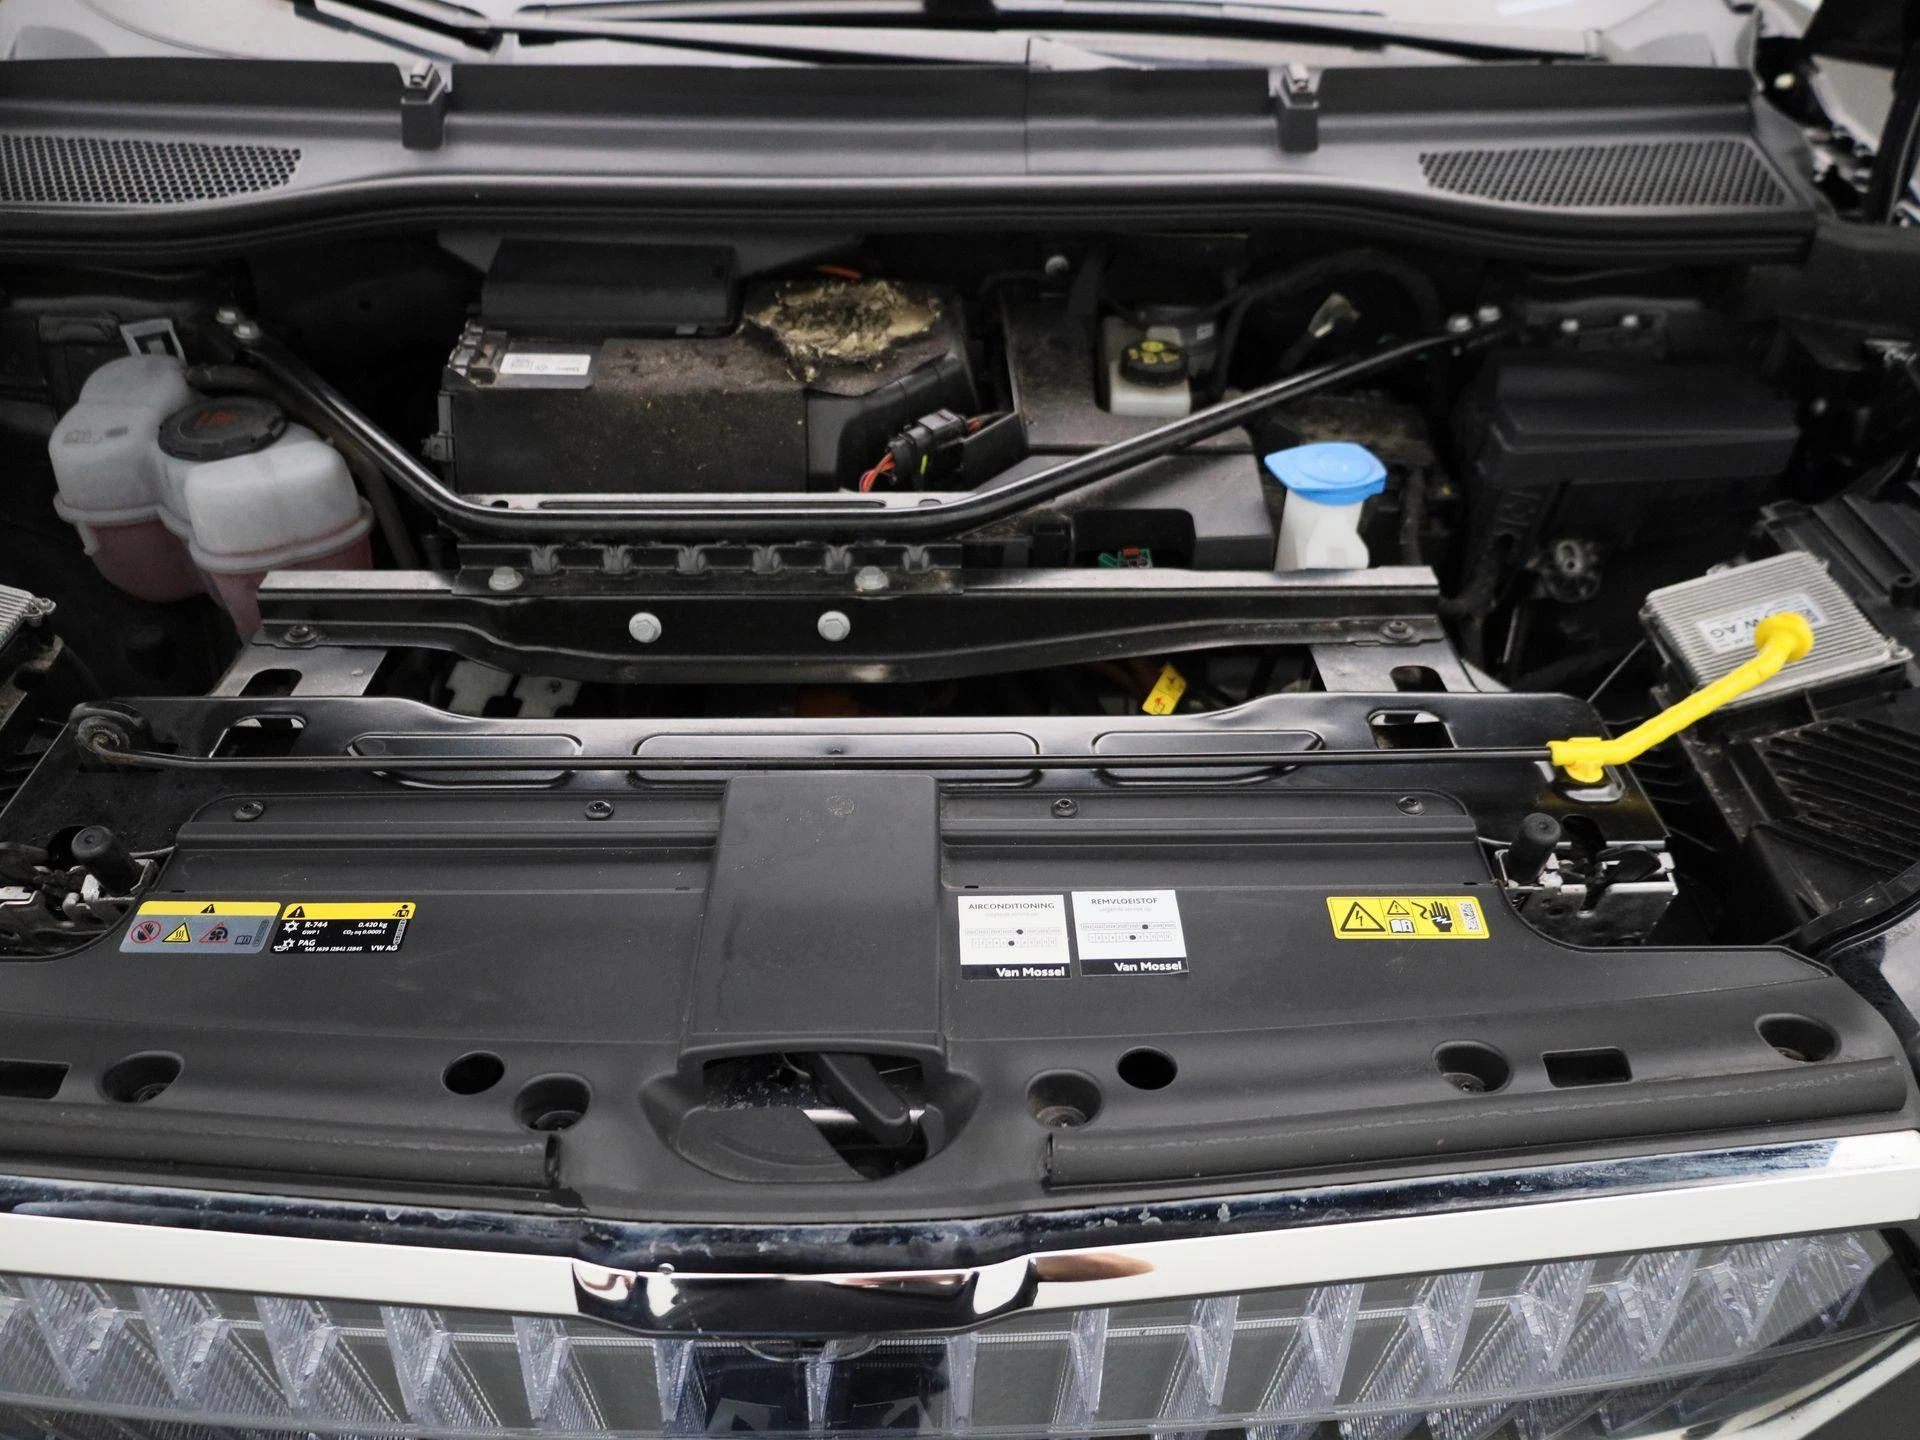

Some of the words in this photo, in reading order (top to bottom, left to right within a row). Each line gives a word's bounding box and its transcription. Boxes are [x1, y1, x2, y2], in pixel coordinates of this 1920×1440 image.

[1091, 897, 1159, 906] REMVLOEISTOF
[967, 902, 1055, 911] AIRCONDITIONING
[304, 921, 328, 929] R-744
[297, 939, 317, 947] PAG
[1113, 962, 1139, 972] Van
[1141, 960, 1182, 972] Mossel
[995, 967, 1020, 977] Van
[1022, 966, 1065, 977] Mossel
